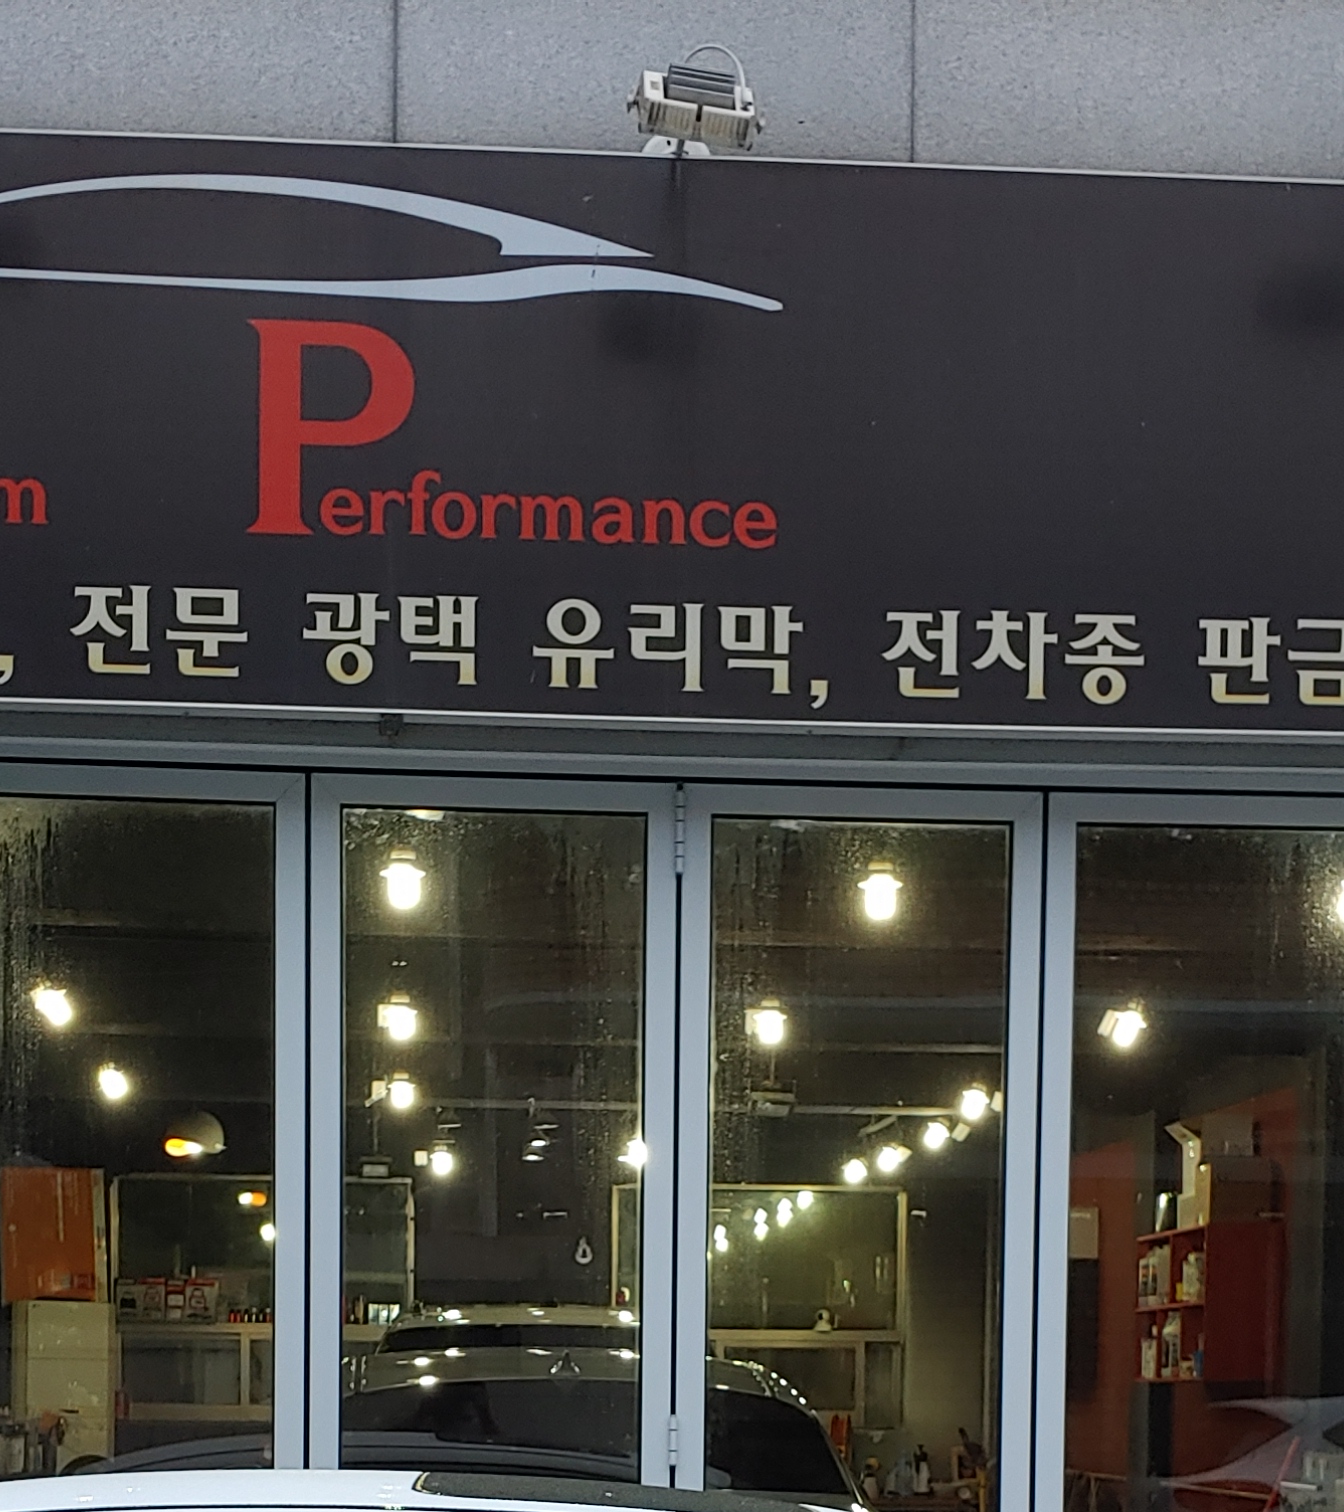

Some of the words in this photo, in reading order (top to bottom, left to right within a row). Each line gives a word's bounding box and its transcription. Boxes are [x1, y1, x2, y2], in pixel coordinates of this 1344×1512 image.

[247, 318, 777, 549] Performance
[69, 585, 248, 678] 전문
[302, 592, 479, 685] 광택
[532, 598, 828, 709] 유리막,
[881, 610, 1145, 705] 전차종
